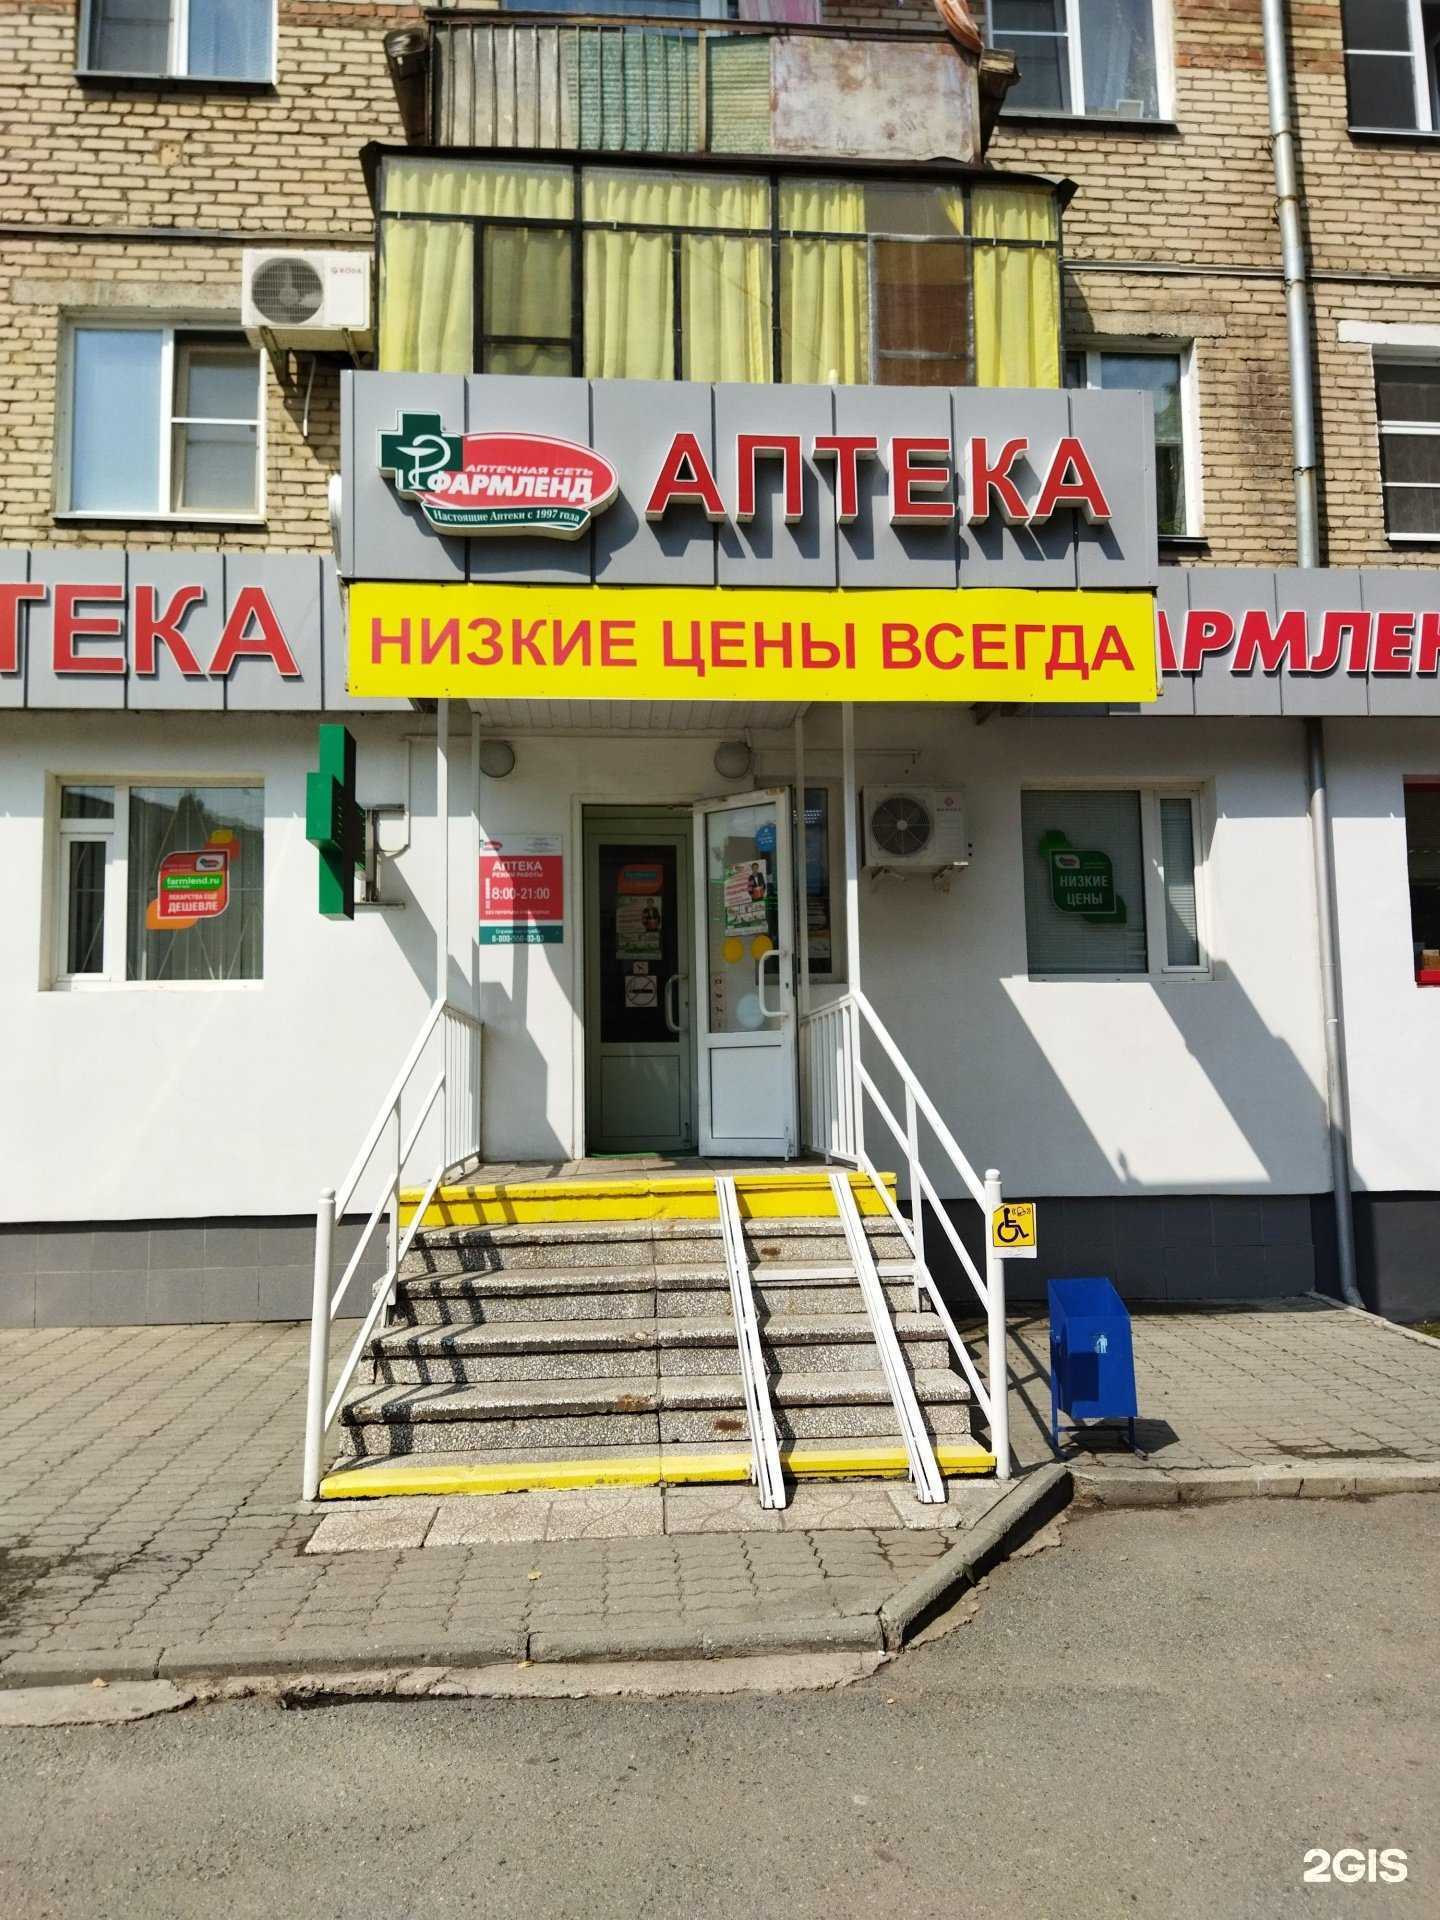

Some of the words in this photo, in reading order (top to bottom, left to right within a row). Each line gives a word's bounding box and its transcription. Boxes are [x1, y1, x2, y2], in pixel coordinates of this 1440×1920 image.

[465, 464, 549, 475] АПТЕЧНАЯ
[553, 466, 594, 476] СЕТЬ
[644, 432, 1112, 524] АПТЕКА
[427, 470, 594, 503] ФАРМЛЕНД
[434, 509, 489, 523] Настоящие
[490, 511, 525, 521] Аптеки
[527, 512, 533, 520] с
[536, 509, 558, 520] 1997
[559, 512, 580, 523] года
[371, 617, 638, 667] НИЗКИЕ
[663, 619, 856, 678] ЦЕНЫ
[881, 622, 1135, 681] ВСЕГДА
[492, 861, 543, 871] АПТЕКА
[1060, 875, 1110, 887] НИЗКИЕ
[1067, 892, 1103, 907] ЦЕНЫ
[168, 901, 218, 914] ДЕШЕВЛЕ
